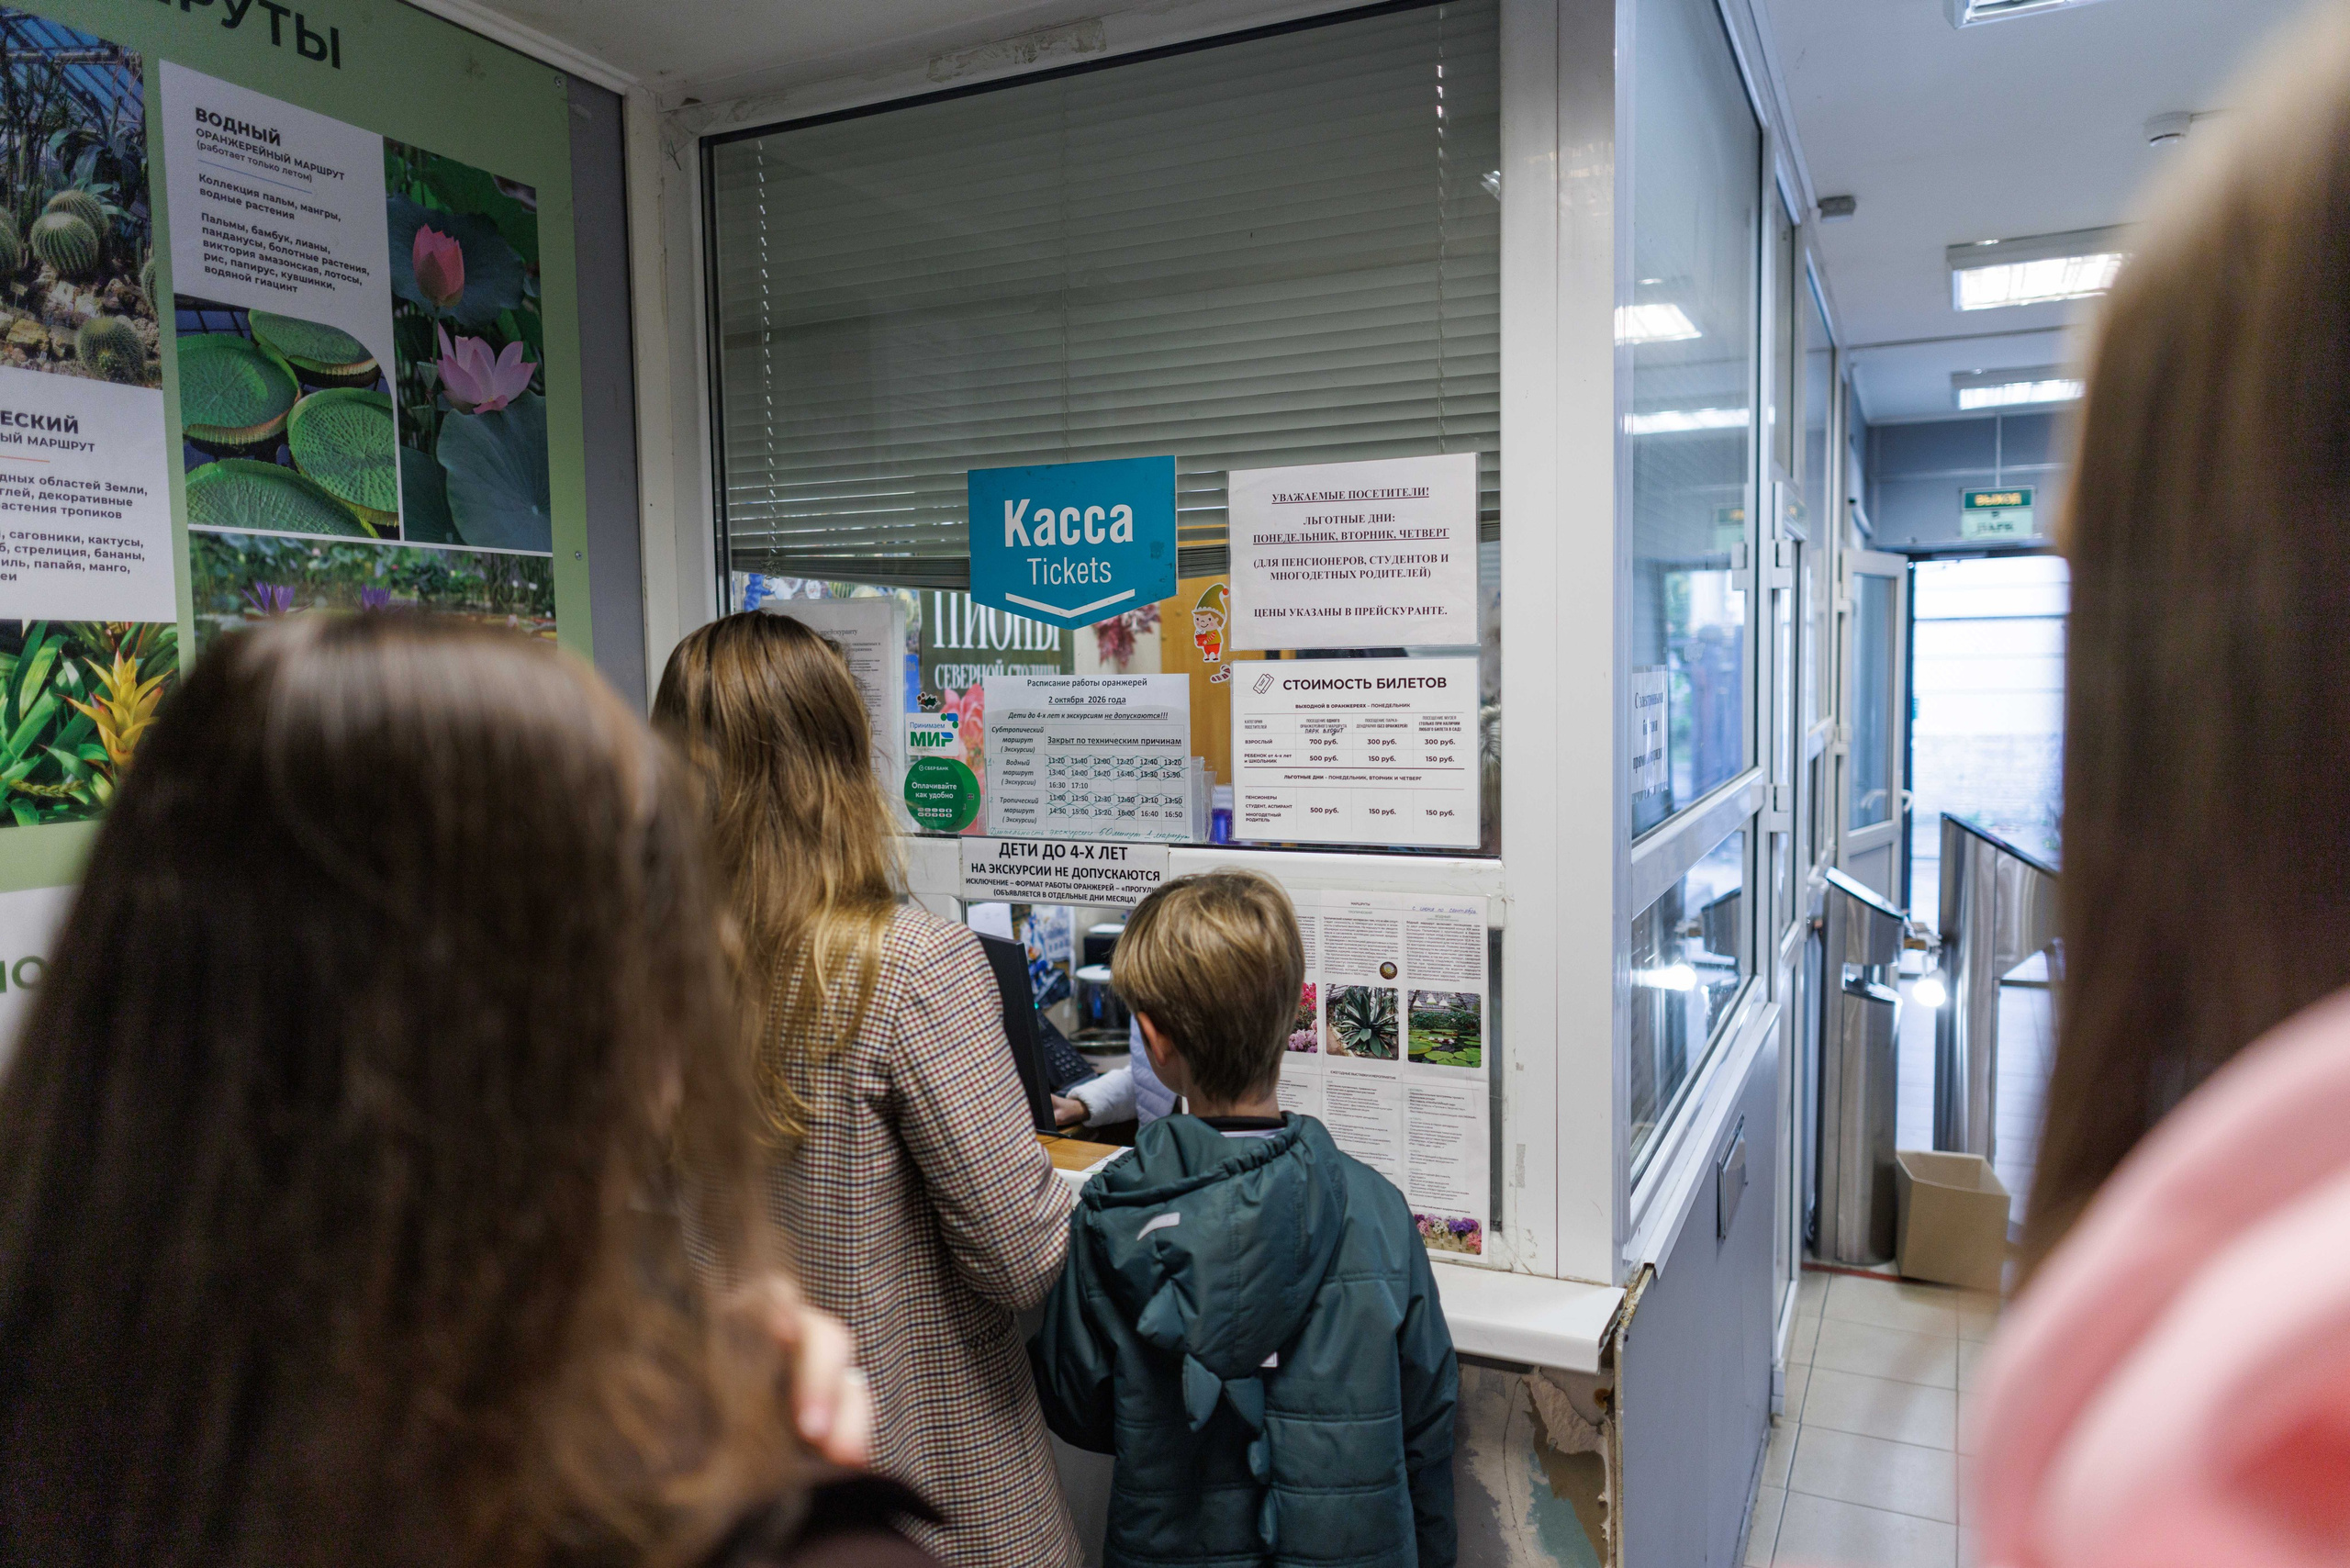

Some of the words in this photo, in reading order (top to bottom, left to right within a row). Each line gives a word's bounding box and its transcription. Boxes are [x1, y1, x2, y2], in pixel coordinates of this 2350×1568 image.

[158, 0, 341, 70] УТЫ
[196, 107, 281, 147] ВОДНЫЙ
[196, 128, 291, 163] ОРАНЖЕРЕЙНЫЙ
[294, 158, 345, 181] МАРШРУТ
[196, 140, 245, 162] (работает
[248, 155, 280, 172] только
[282, 166, 313, 183] летом)
[198, 174, 260, 198] Коллекция
[263, 193, 297, 210] пальм,
[300, 204, 341, 222] мангры,
[199, 188, 242, 206] водные
[245, 199, 295, 219] растения
[201, 212, 249, 233] Пальмы,
[251, 225, 293, 245] бамбук,
[296, 238, 330, 254] лианы,
[202, 227, 266, 251] панданусы,
[268, 241, 319, 262] болотные
[321, 257, 370, 275] растения,
[203, 240, 256, 261] виктория
[258, 252, 322, 275] амазонская,
[324, 269, 363, 286] лотосы,
[204, 252, 228, 266] рис,
[230, 259, 278, 277] папирус,
[280, 271, 336, 291] кувшинки,
[204, 265, 252, 283] водяной
[254, 277, 298, 293] гиацинт
[28, 435, 95, 453] МАРШРУТ
[39, 476, 101, 491] областей
[105, 482, 148, 497] Земли,
[39, 490, 133, 507] декоративные
[1271, 490, 1346, 503] УВАЖАЕМЫЕ
[1348, 487, 1429, 499] ПОСЕТИТЕЛИ!
[1975, 492, 2022, 507] ВЫХОД
[0, 501, 57, 514] астения
[61, 507, 122, 520] тропиков
[1004, 499, 1134, 548] Касса
[1304, 514, 1365, 525] ЛЬГОТНЫЕ
[1368, 513, 1395, 524] ДНИ:
[9, 530, 84, 544] саговники,
[88, 536, 144, 549] кактусы,
[1253, 532, 1338, 543] ПОНЕДЕЛЬНИК,
[1341, 530, 1396, 541] ВТОРНИК,
[1399, 528, 1449, 539] ЧЕТВЕРГ
[14, 544, 91, 559] стрелиция,
[94, 547, 145, 562] бананы,
[33, 559, 85, 572] папайя,
[89, 563, 130, 574] манго,
[1253, 557, 1279, 568] (ДЛЯ
[1281, 555, 1367, 567] ПЕНСИОНЕРОВ,
[1369, 554, 1438, 566] СТУДЕНТОВ
[1441, 554, 1449, 563] И
[1026, 556, 1113, 586] Tickets
[1270, 570, 1356, 581] МНОГОДЕТНЫХ
[1360, 567, 1431, 579] РОДИТЕЛЕЙ)
[1254, 609, 1286, 618] ЦЕНЫ
[1289, 608, 1342, 617] УКАЗАНЫ
[1345, 608, 1351, 617] В
[1354, 605, 1448, 617] ПРЕЙСКУРАНТЕ.
[933, 591, 1061, 652] ПИОНЫ
[1027, 679, 1070, 688] Расписание
[1072, 679, 1100, 689] работы
[1102, 678, 1147, 689] оранжерей
[1282, 678, 1371, 690] СТОИМОСТЬ
[1377, 677, 1447, 689] БИЛЕТОВ
[1054, 696, 1084, 705] октября
[1108, 697, 1126, 705] года
[1008, 711, 1025, 720] Дети
[1066, 712, 1103, 721] экскурсиям
[1113, 711, 1169, 721] допускаются!!!
[991, 725, 1045, 735] Субтропический
[910, 731, 954, 747] МИР
[1002, 736, 1034, 745] маршрут
[1047, 736, 1075, 745] Закрыт
[1140, 737, 1182, 746] причинам
[1382, 738, 1397, 746] руб.
[1440, 738, 1455, 746] руб.
[1324, 755, 1338, 763] руб.
[1002, 769, 1034, 778] маршрут
[912, 781, 957, 790] Оплачивайте
[929, 791, 954, 801] удобно
[1000, 797, 1039, 805] Тропический
[1003, 808, 1035, 816] маршрут
[1382, 808, 1396, 816] руб.
[999, 842, 1038, 858] ДЕТИ
[1042, 844, 1066, 860] ДО
[1070, 846, 1094, 859] 4-Х
[1099, 846, 1128, 860] ЛЕТ
[971, 863, 986, 873] НА
[989, 863, 1052, 877] ЭКСКУРСИИ
[1055, 867, 1069, 877] НЕ
[1071, 868, 1160, 881] ДОПУСКАЮТСЯ
[966, 878, 1009, 887] ИСКЛЮЧЕНИЕ
[1015, 880, 1044, 889] ФОРМАТ
[1045, 882, 1072, 890] РАБОТЫ
[1074, 882, 1114, 891] ОРАНЖЕРЕЙ
[993, 889, 1041, 899] (ОБЪЯВЛЯЕТСЯ
[1048, 892, 1088, 901] ОТДЕЛЬНЫЕ
[1090, 894, 1104, 902] ДНИ
[1106, 895, 1136, 904] МЕСЯЦА)
